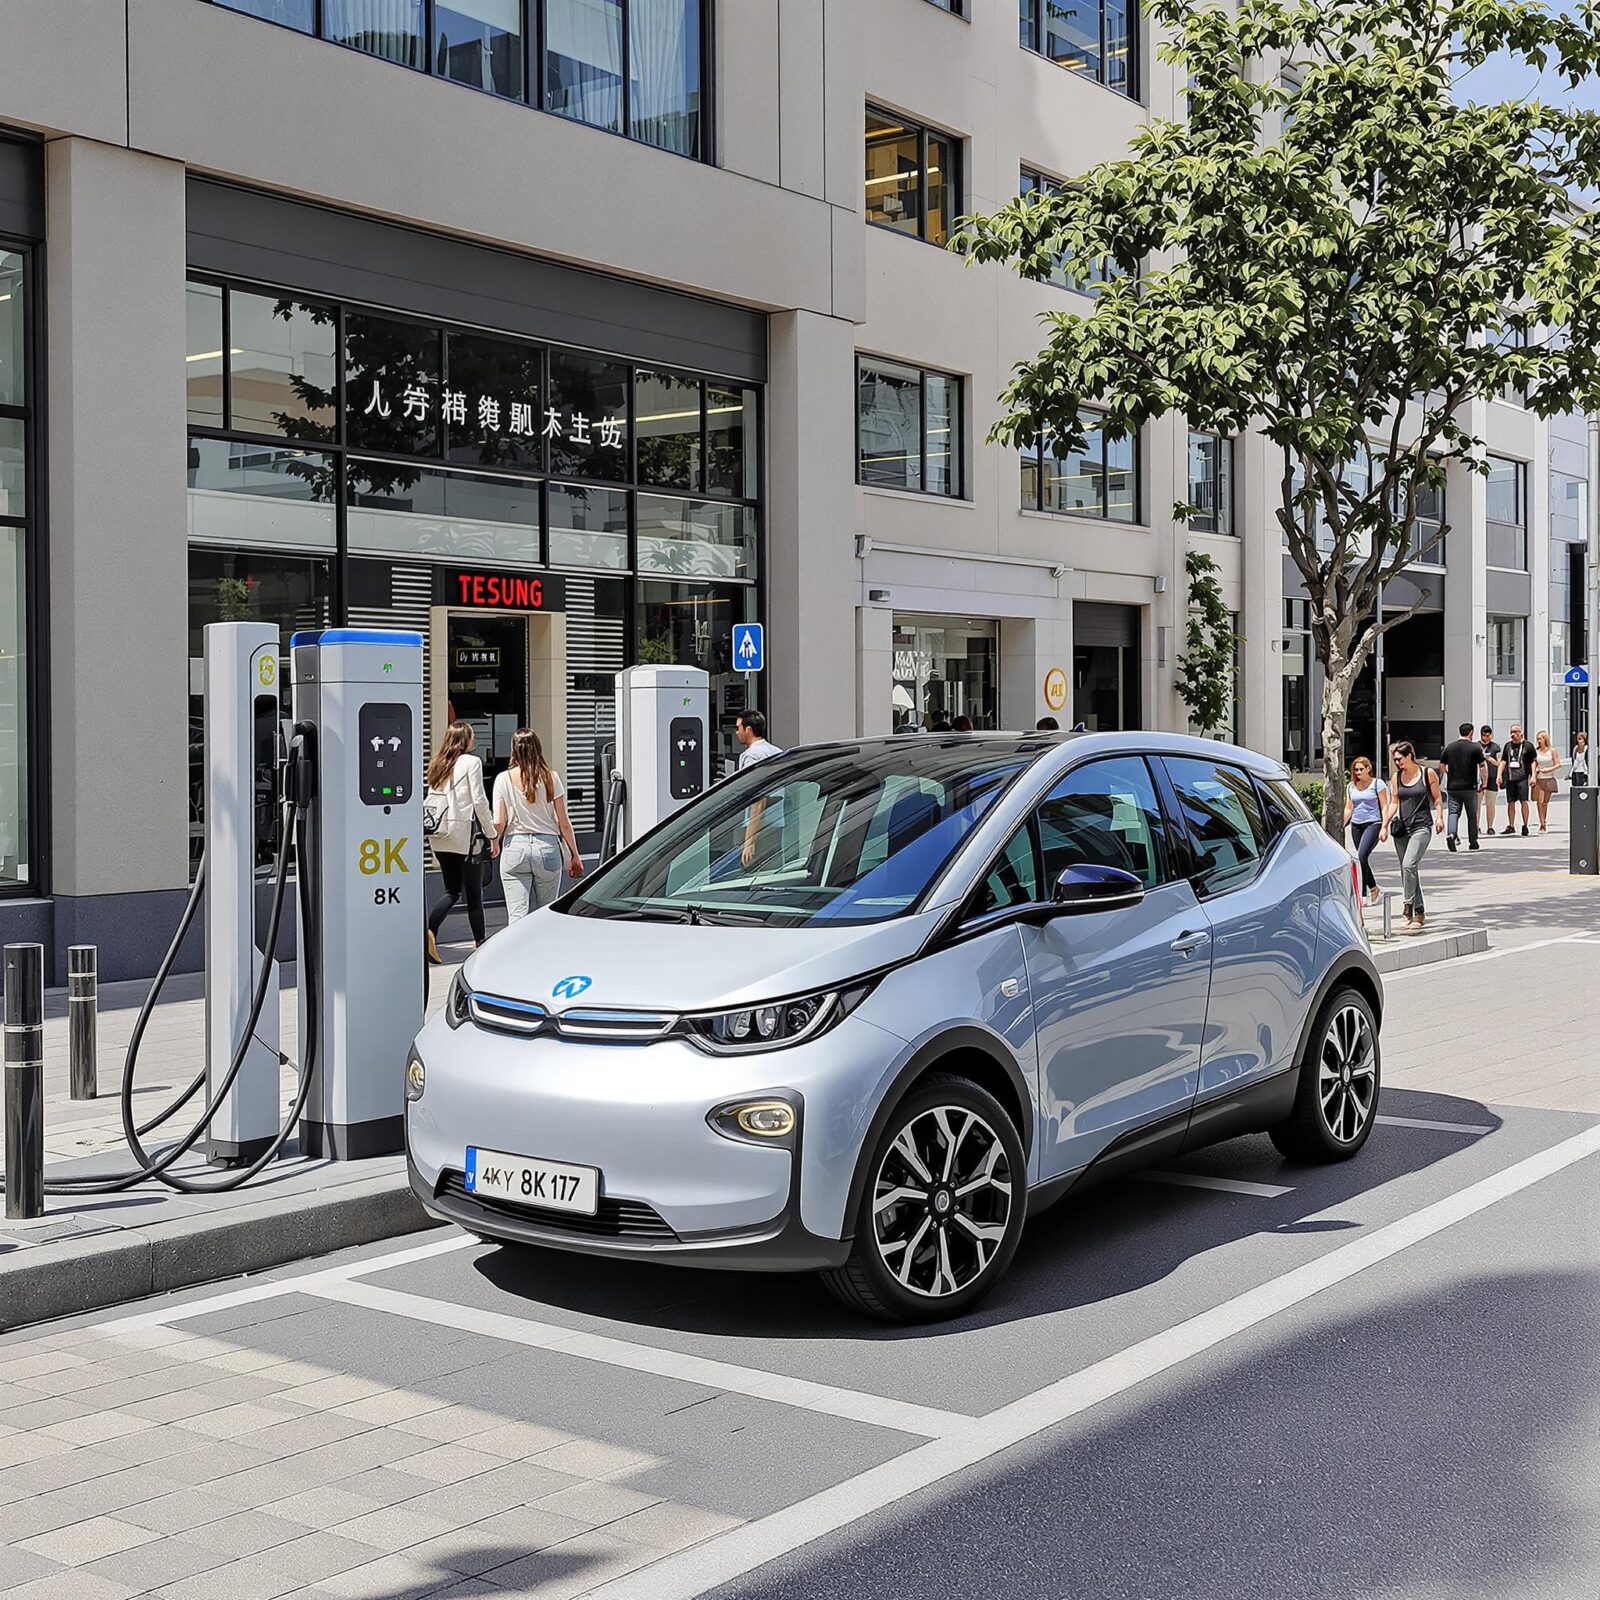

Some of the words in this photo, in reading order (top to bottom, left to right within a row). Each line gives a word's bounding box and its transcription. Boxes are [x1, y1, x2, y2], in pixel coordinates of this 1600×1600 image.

[459, 575, 542, 607] TESUNG
[359, 837, 409, 875] 8K
[374, 887, 401, 905] 8K
